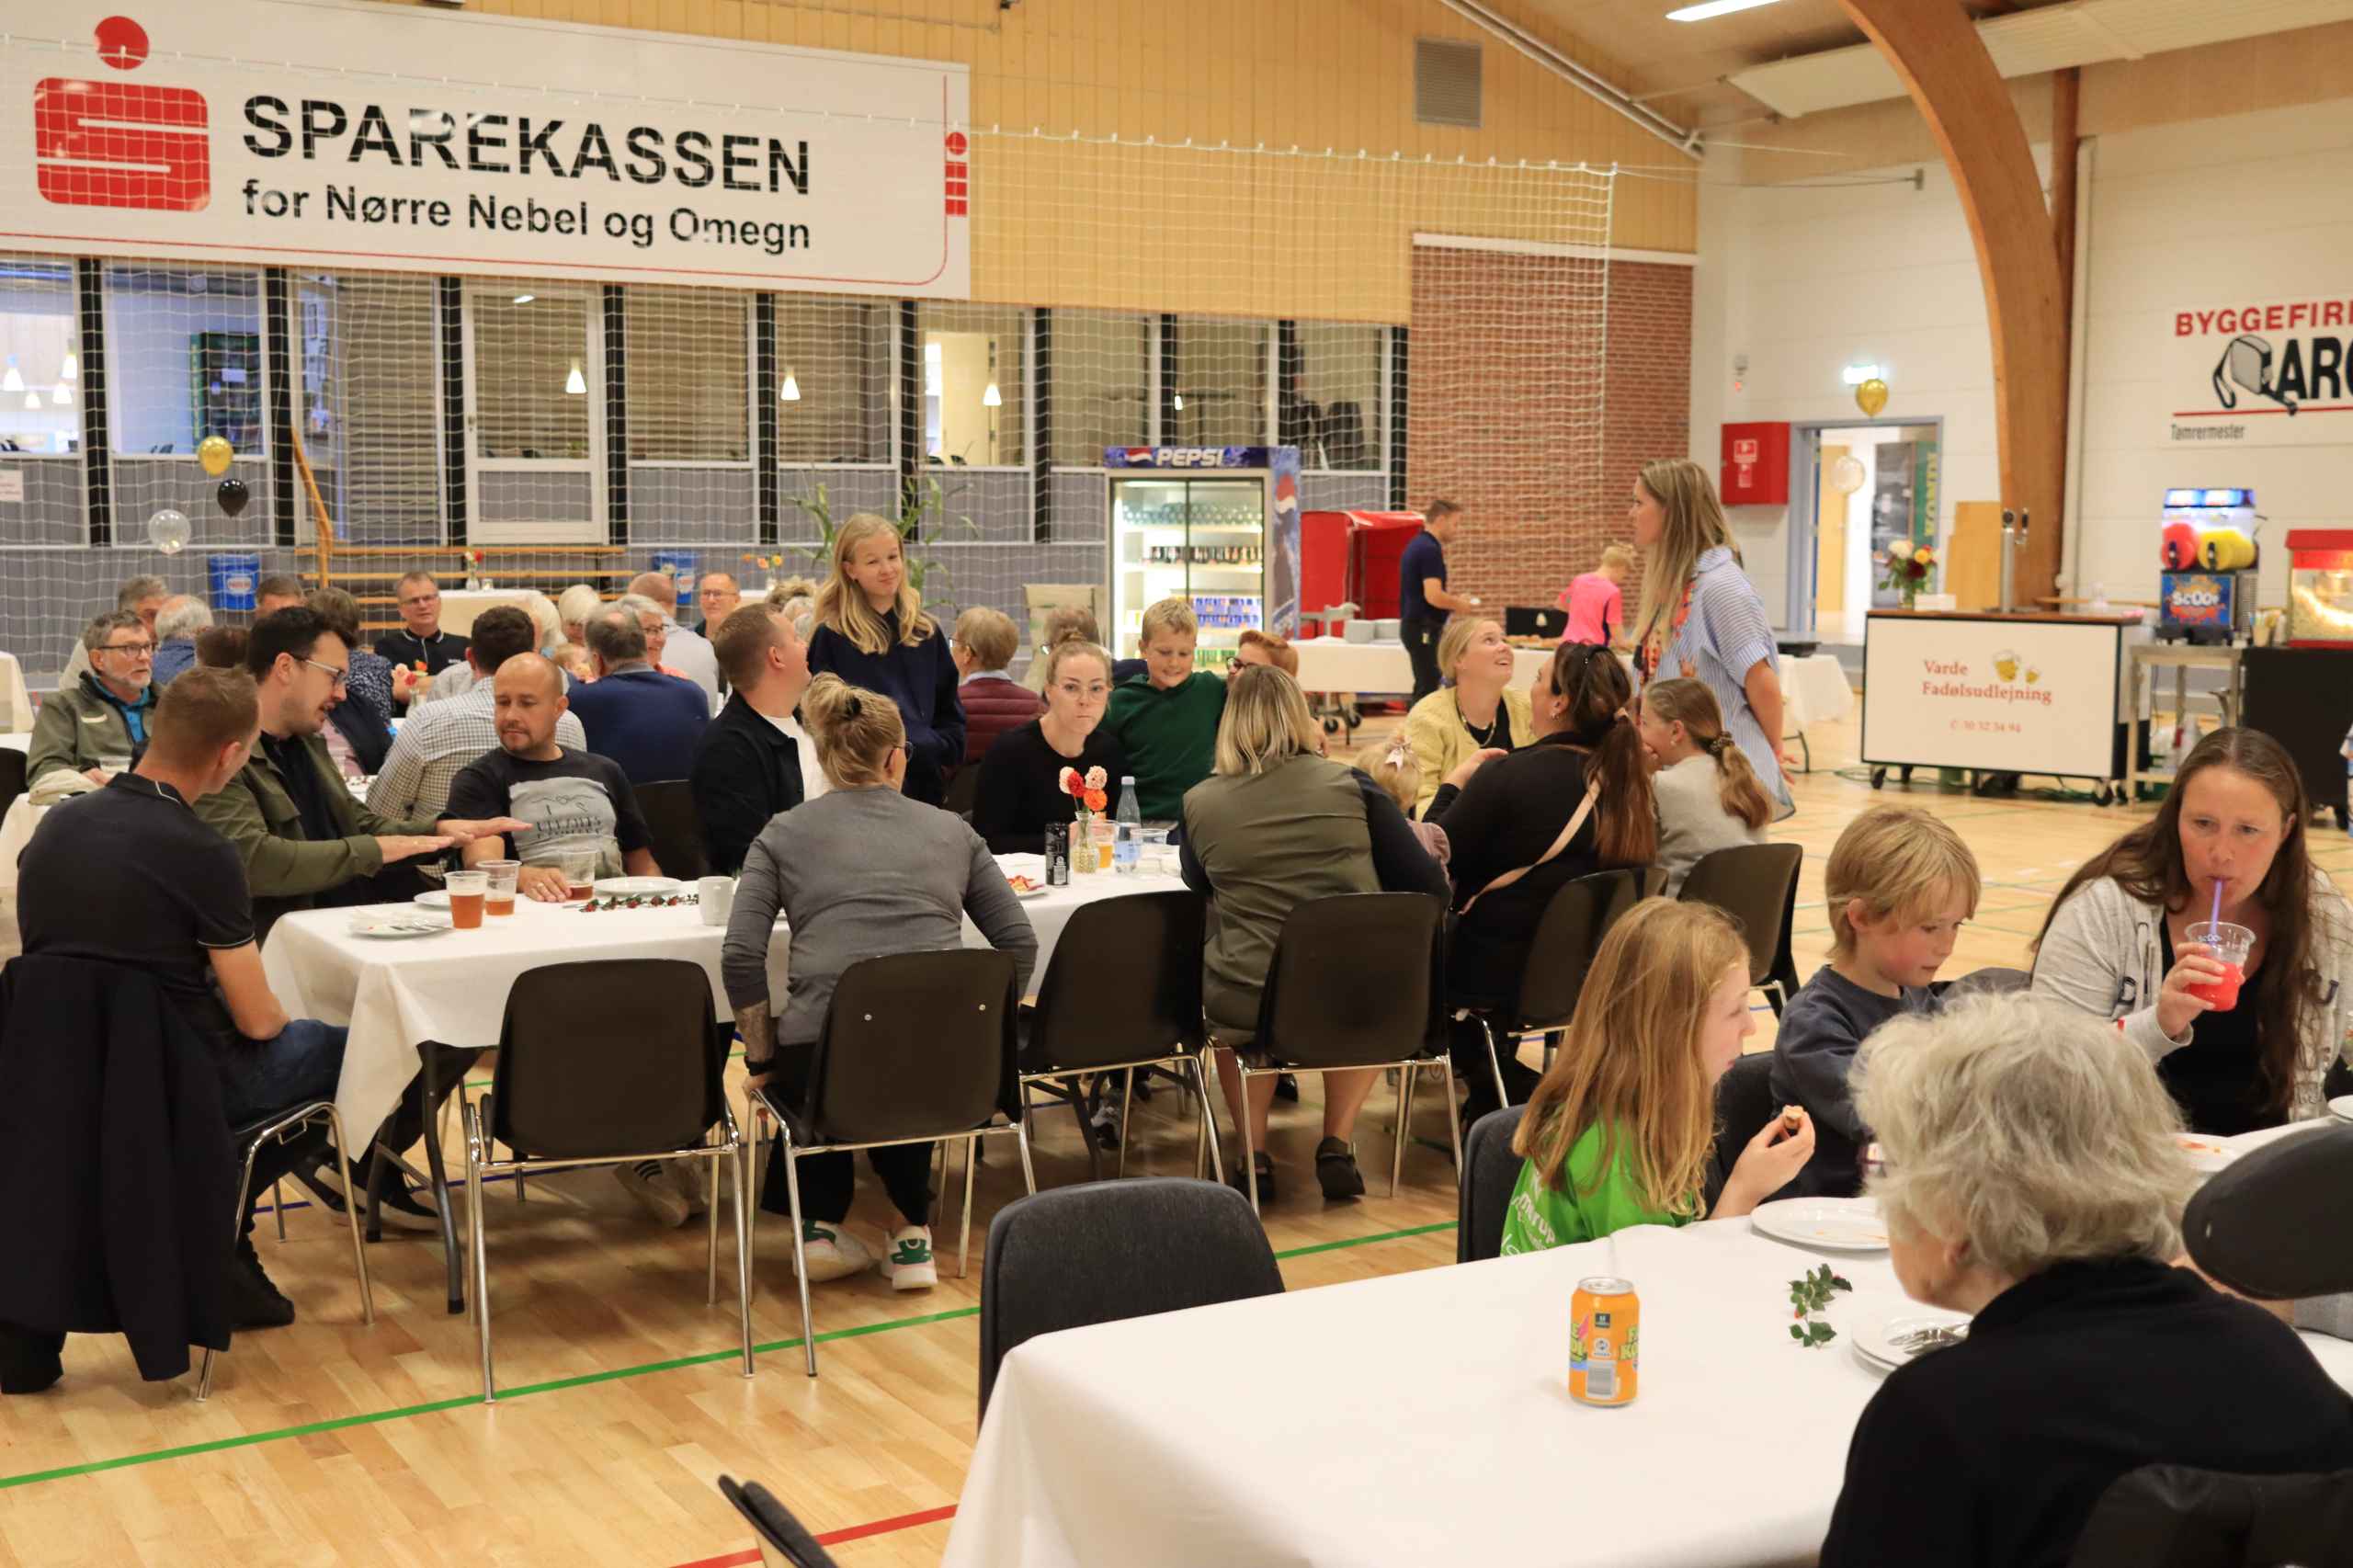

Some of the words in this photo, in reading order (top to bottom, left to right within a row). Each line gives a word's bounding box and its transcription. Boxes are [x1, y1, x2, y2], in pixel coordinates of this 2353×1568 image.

[243, 95, 809, 196] SPAREKASSEN
[242, 179, 311, 219] for
[326, 184, 452, 227] Nørre
[469, 193, 588, 236] Nebel
[603, 211, 654, 249] og
[668, 207, 811, 256] Omegn
[2175, 299, 2353, 337] BYGGEFIR
[2276, 336, 2353, 400] AR
[1156, 448, 1225, 467] PEPSI
[1924, 660, 1968, 675] Varde
[1922, 681, 2052, 705] Fadølsudlejning
